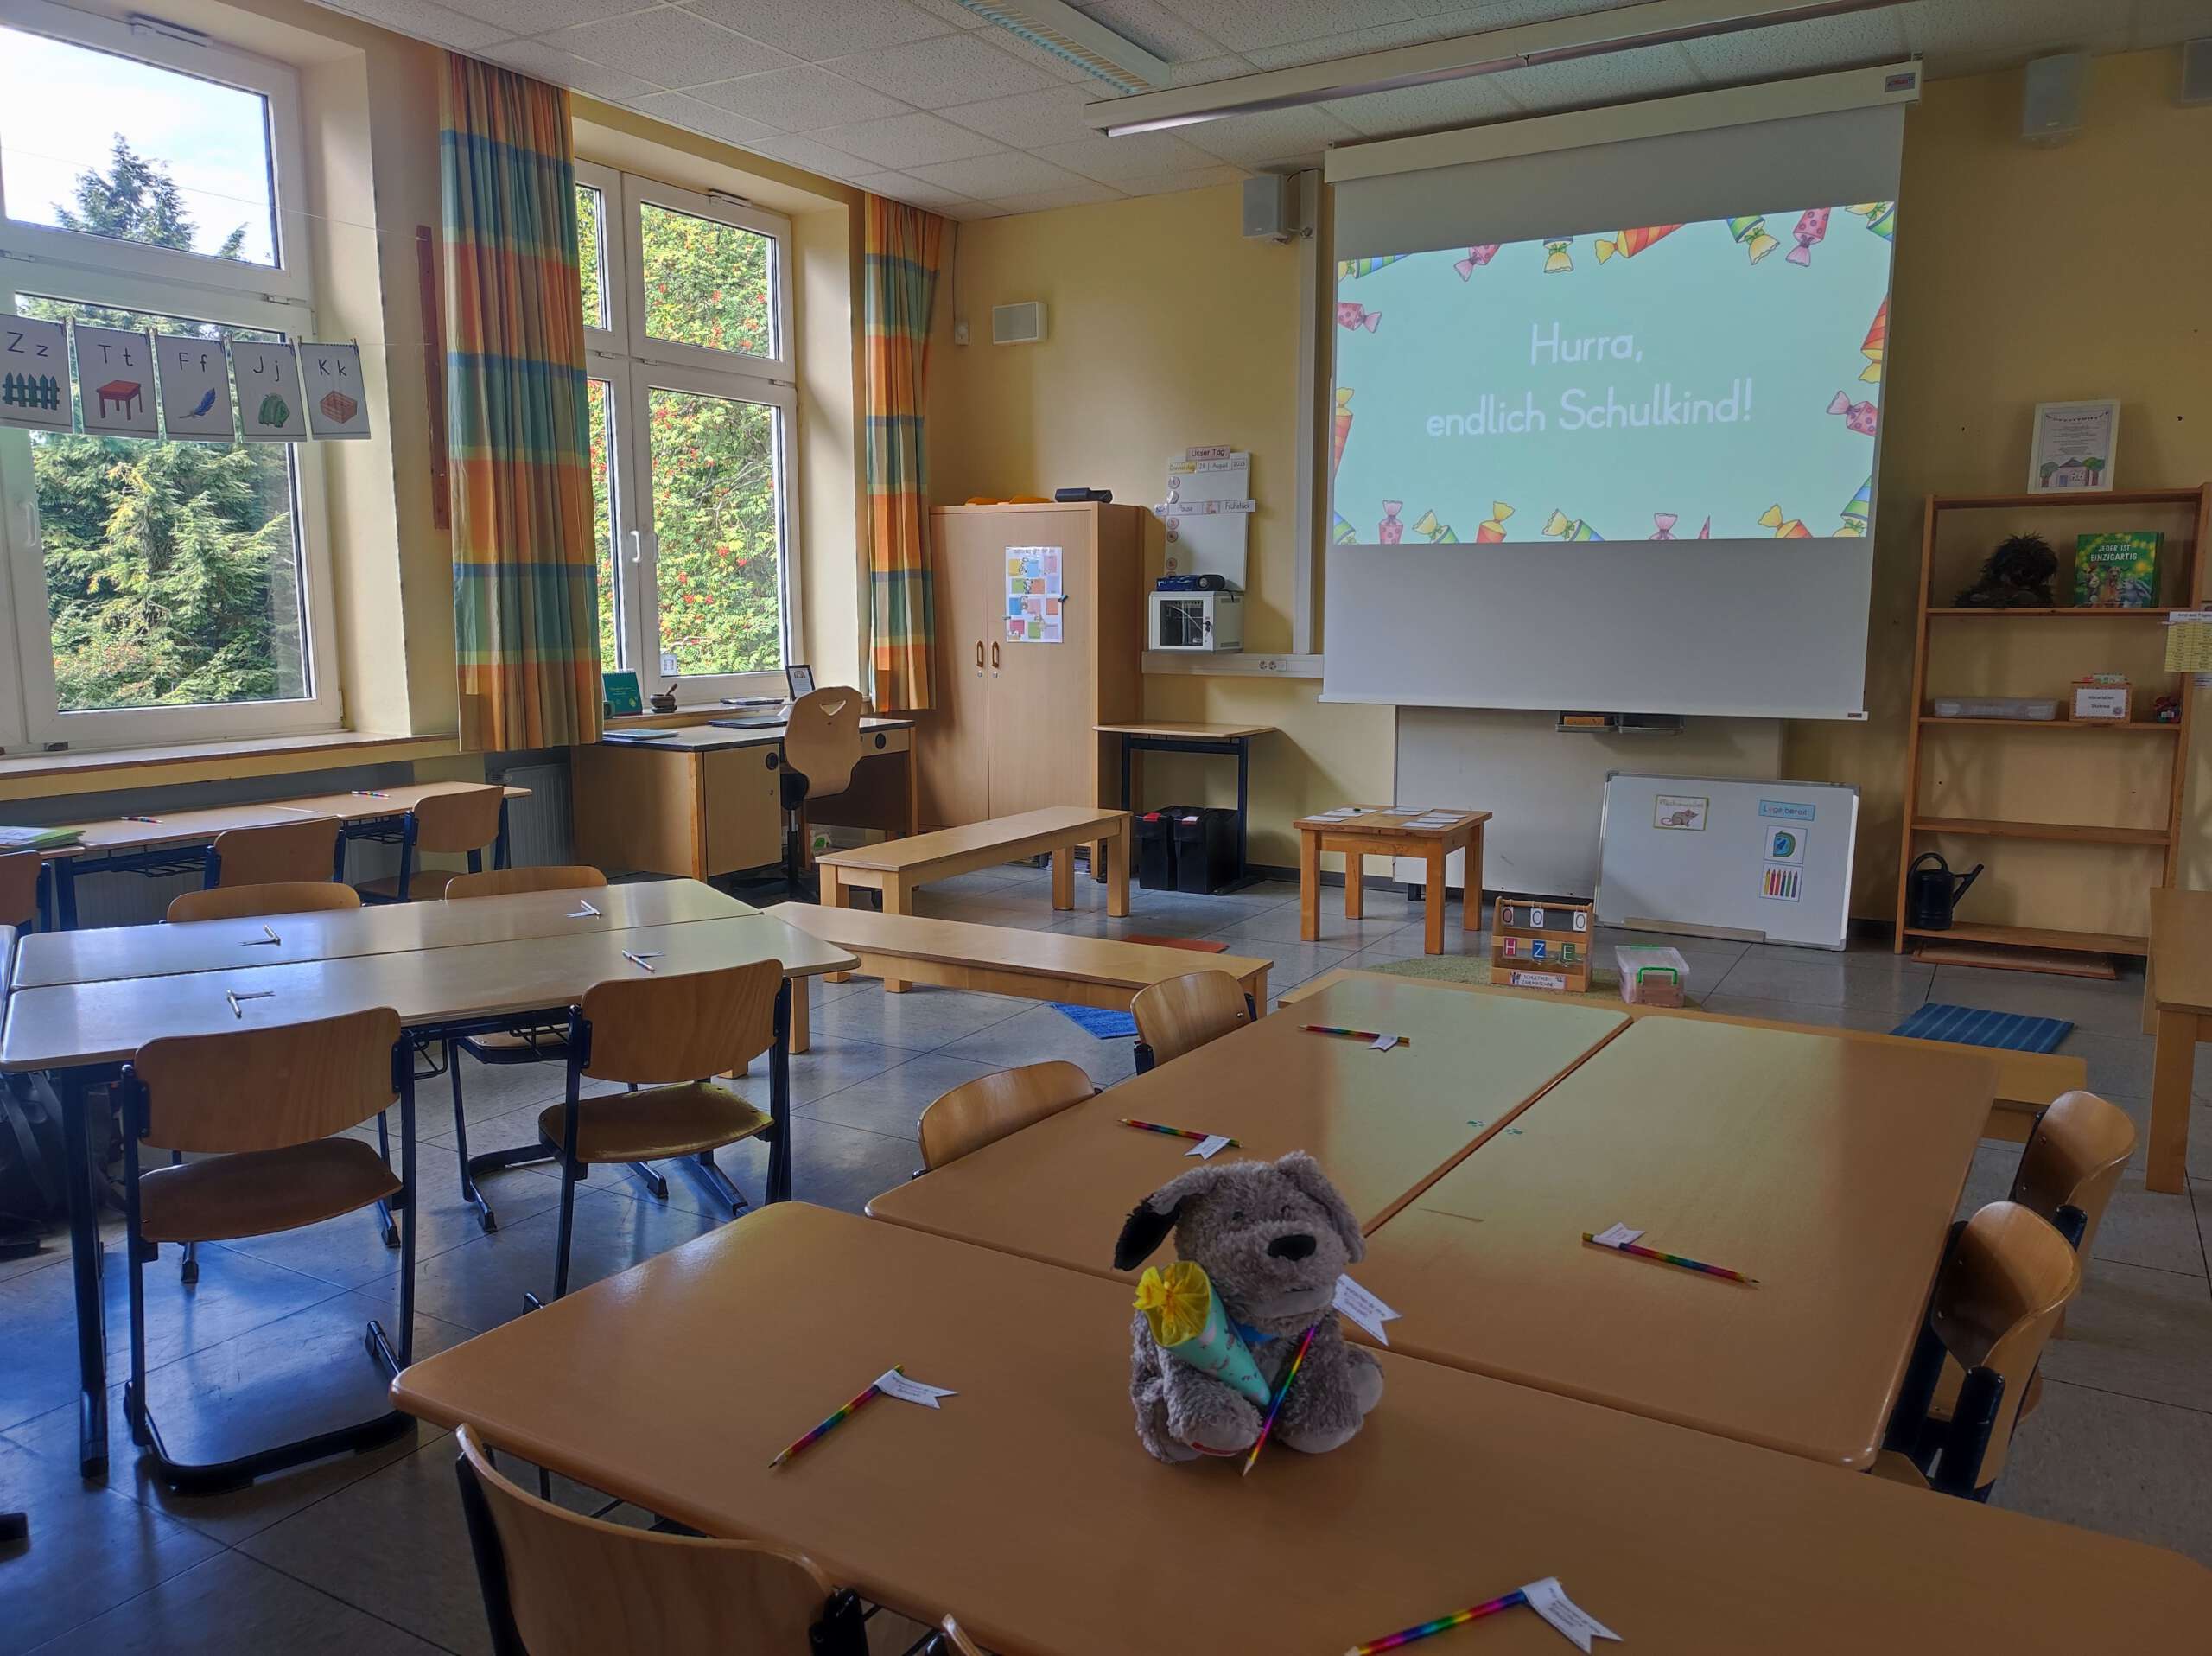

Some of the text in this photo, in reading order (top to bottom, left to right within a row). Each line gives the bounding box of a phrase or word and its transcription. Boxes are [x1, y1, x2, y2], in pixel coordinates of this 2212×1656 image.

[6, 331, 25, 353] Z
[1530, 322, 1642, 366] Hurra,
[97, 345, 134, 367] T t
[178, 352, 208, 373] F f
[318, 358, 330, 376] K
[253, 356, 280, 382] J j
[1426, 377, 1752, 436] endlich Schulkind!
[1212, 449, 1225, 457] Tag
[1224, 500, 1250, 510] Frühstück
[2090, 552, 2138, 562] EINZIGARTIG
[1505, 939, 1573, 961] H Z E
